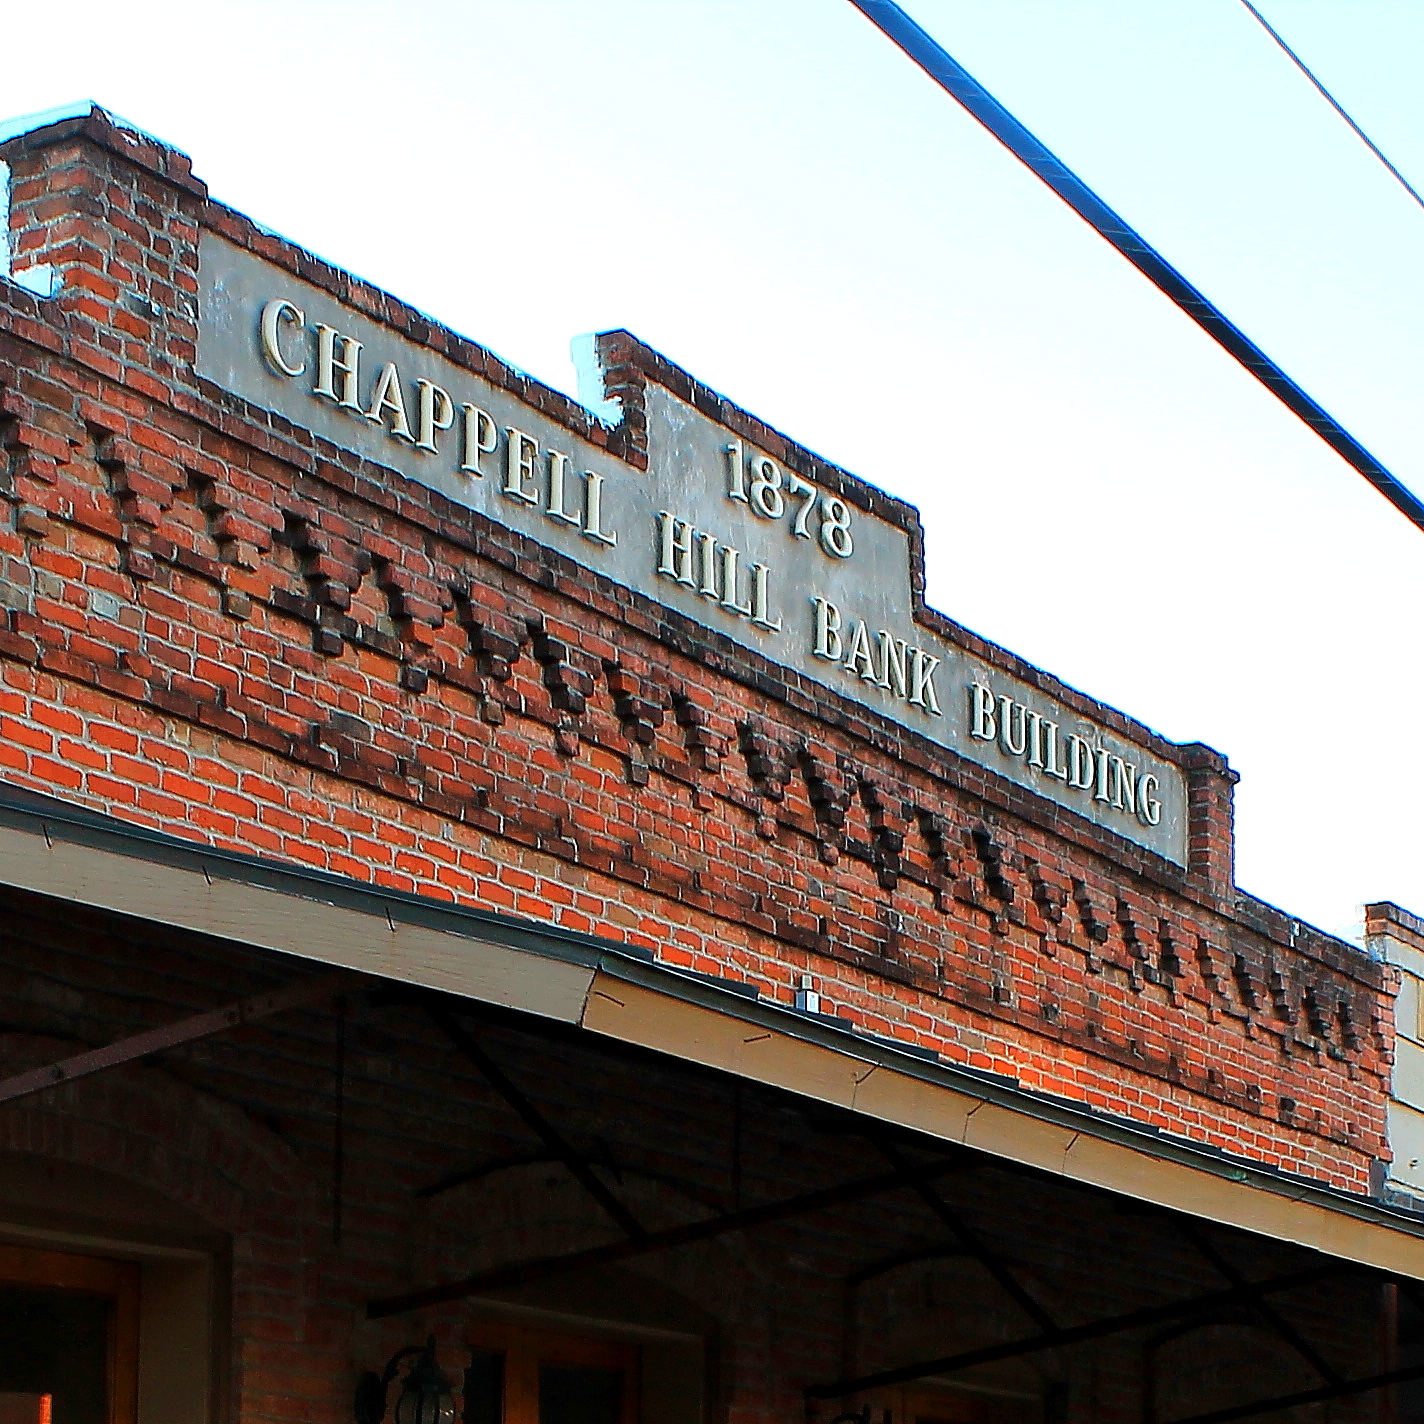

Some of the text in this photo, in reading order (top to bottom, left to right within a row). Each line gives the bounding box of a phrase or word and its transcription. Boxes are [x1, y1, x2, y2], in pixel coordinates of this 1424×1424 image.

[260, 299, 1162, 826] CHAPPELL HILL BANK BUILDING
[726, 440, 854, 559] 1878
